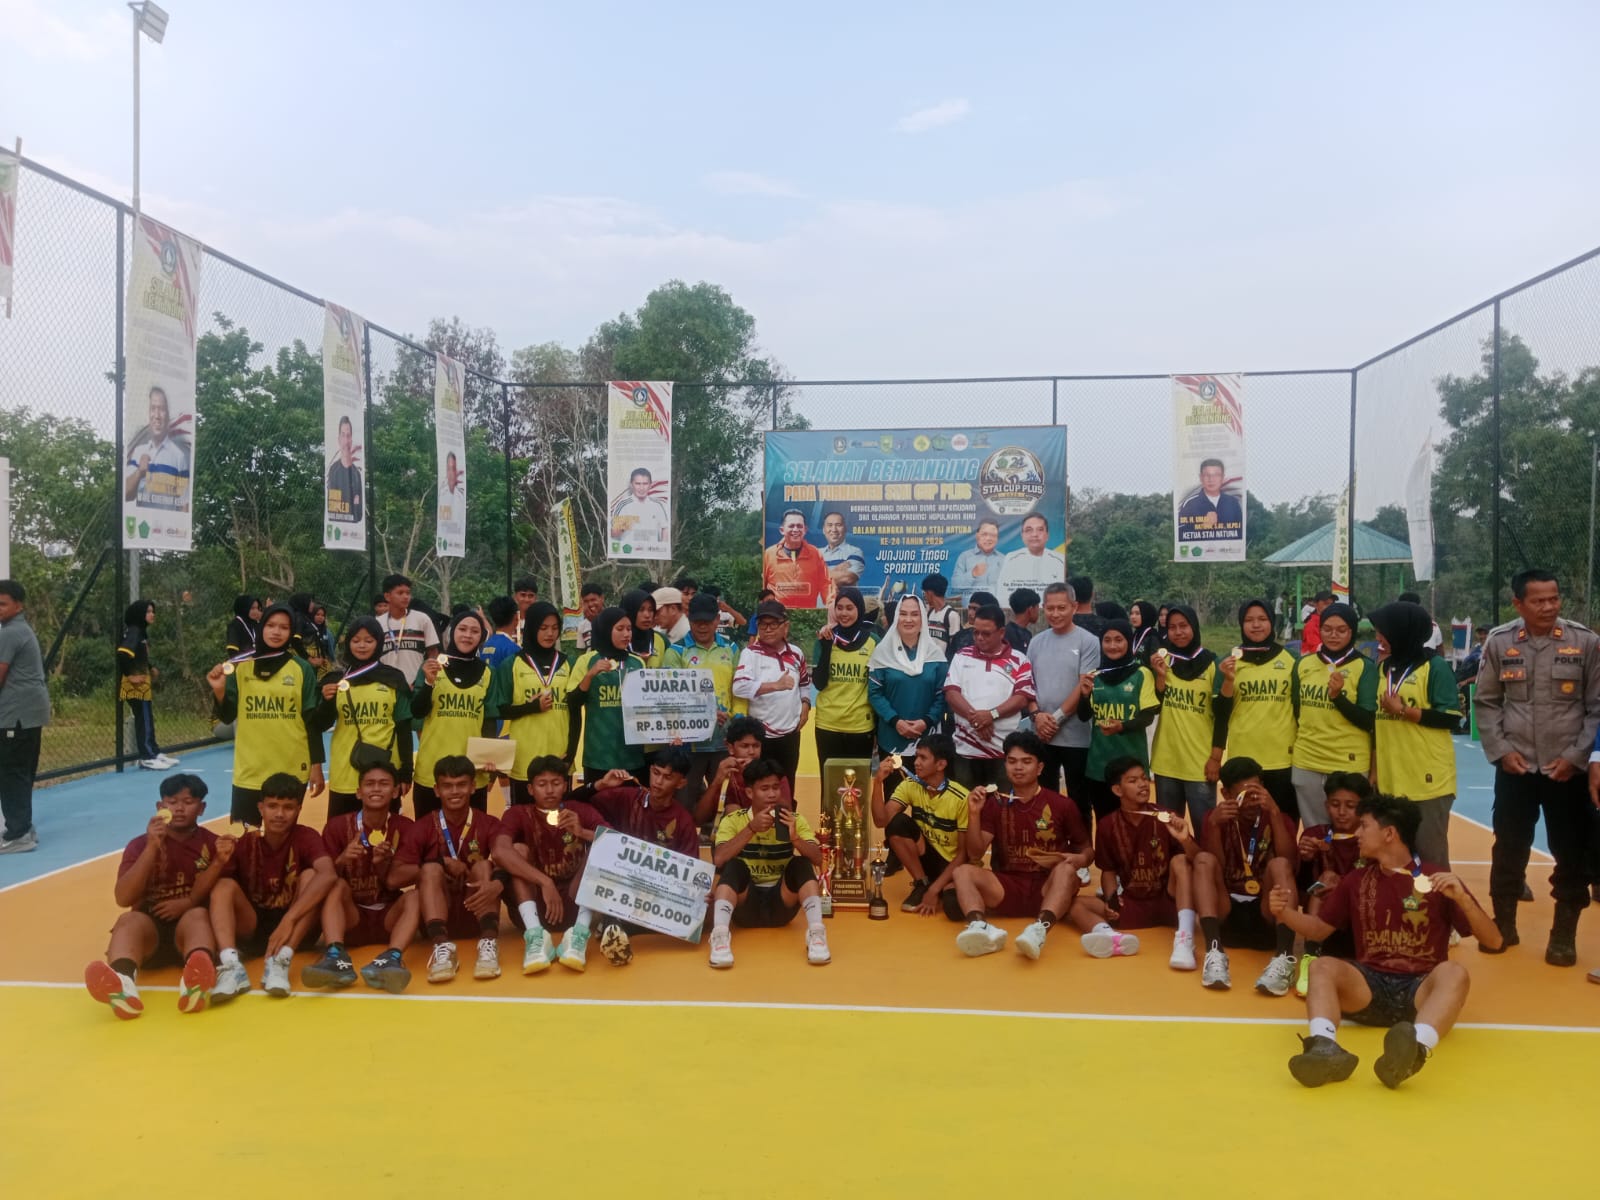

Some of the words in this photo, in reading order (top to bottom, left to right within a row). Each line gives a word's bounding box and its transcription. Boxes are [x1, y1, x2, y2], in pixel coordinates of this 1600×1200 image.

[783, 459, 868, 483] SELAMAT
[868, 458, 980, 482] BERTANDING
[784, 485, 817, 502] PADA
[939, 483, 973, 500] PLUS
[982, 484, 1003, 495] STAI
[1003, 484, 1020, 492] CUP
[1022, 484, 1043, 494] PLUS
[852, 526, 876, 535] DALAM
[1182, 531, 1201, 540] KETUA
[1201, 530, 1215, 539] STAI
[1215, 529, 1239, 538] NATUNA
[875, 550, 917, 561] JUNJUNG
[921, 549, 949, 561] TINGGI
[884, 562, 941, 575] SPORTIVITAS
[1554, 656, 1582, 665] POLRI
[831, 662, 861, 678] SMAN
[599, 685, 622, 701] SMA
[641, 679, 690, 693] JUARA
[691, 679, 697, 692] I
[1239, 679, 1278, 697] SMAN
[1281, 680, 1289, 695] 2
[245, 695, 285, 713] SMAN
[288, 697, 297, 713] 2
[438, 693, 475, 711] SMAN
[475, 698, 485, 713] 2
[1164, 686, 1194, 705] SMAN
[1198, 691, 1207, 708] 2
[382, 703, 389, 718] 2
[1093, 703, 1125, 720] SMAN
[1128, 704, 1136, 720] 2
[636, 721, 655, 732] RP.
[655, 718, 710, 731] 8.500.000
[617, 847, 679, 880] JUARA
[681, 867, 690, 882] I
[751, 863, 776, 874] MAN
[176, 871, 185, 886] 9
[594, 885, 617, 902] RP.
[620, 893, 692, 926] 8.500.000
